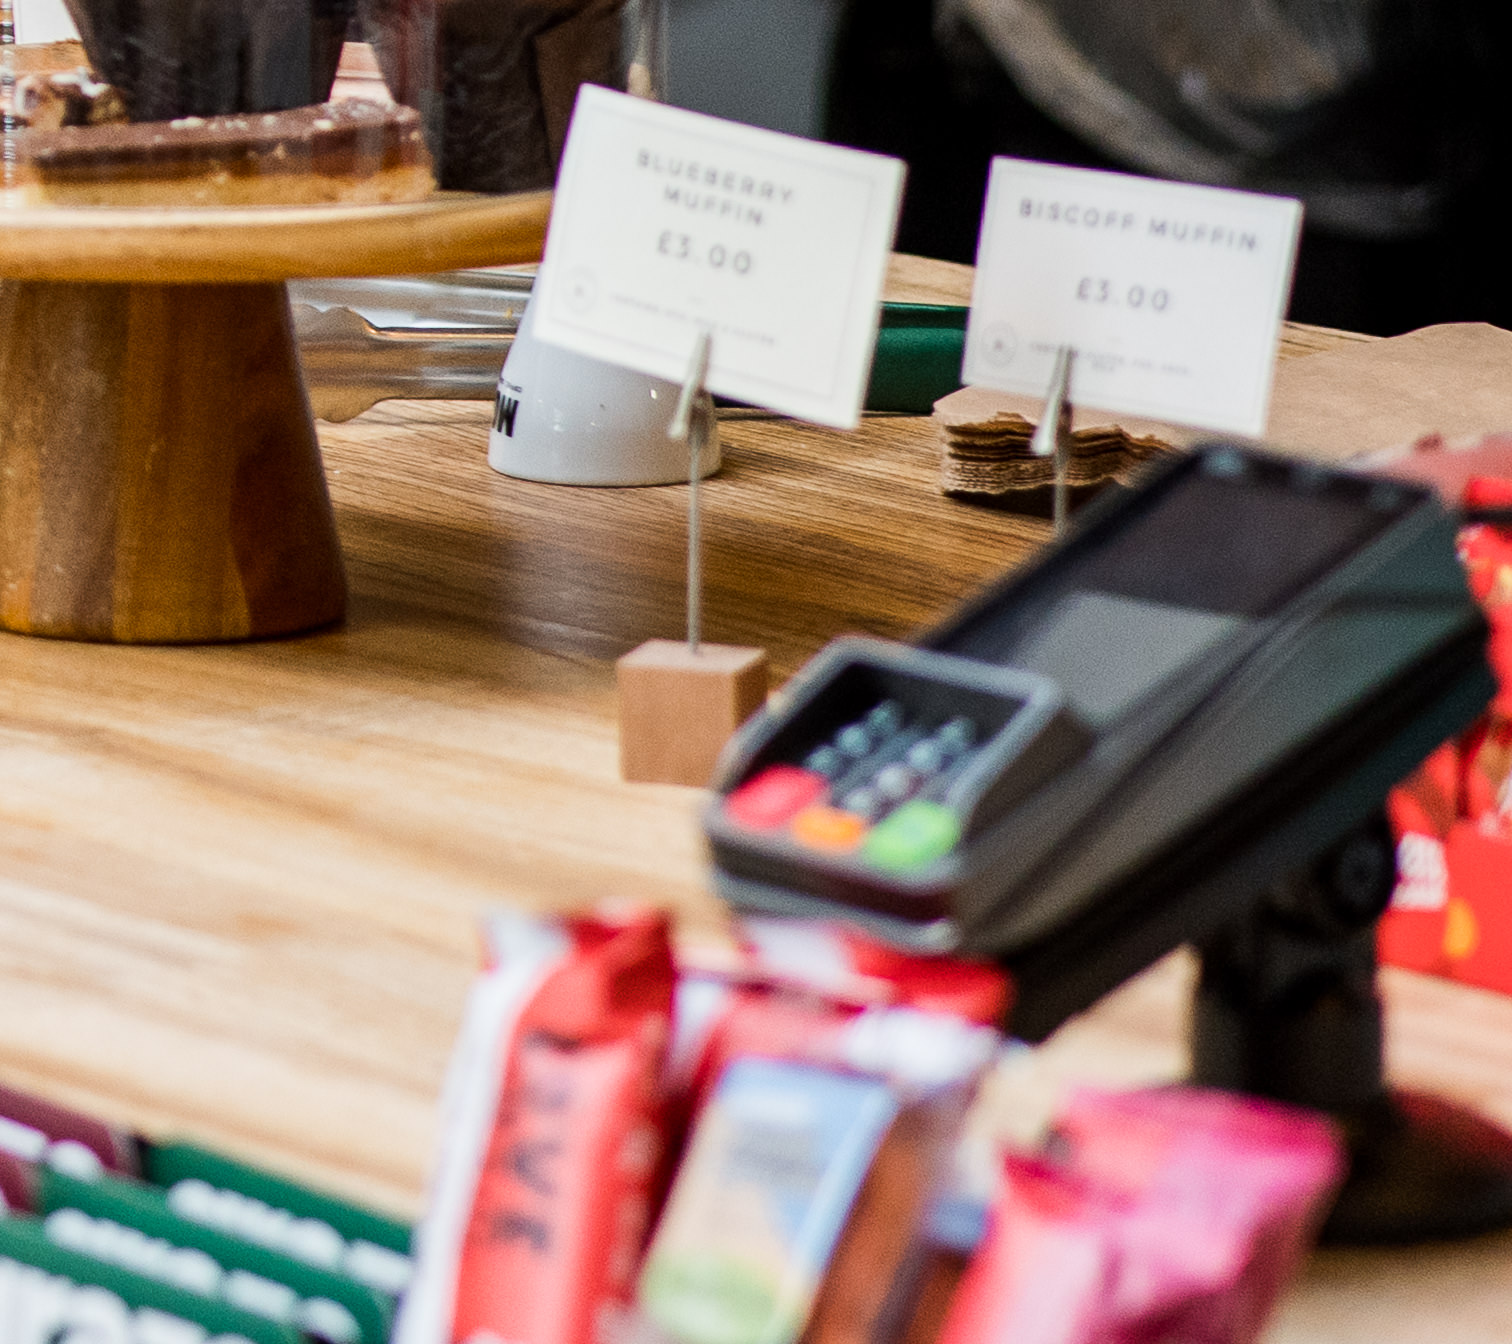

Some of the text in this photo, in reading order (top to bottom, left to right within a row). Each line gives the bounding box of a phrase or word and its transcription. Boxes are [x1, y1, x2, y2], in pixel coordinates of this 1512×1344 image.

[636, 148, 794, 204] BLUEBERRY
[663, 184, 765, 227] MUFFIN
[1019, 198, 1258, 252] BISCOFF MUFFIN
[657, 230, 752, 275] £3.00
[1076, 276, 1172, 313] £3.00
